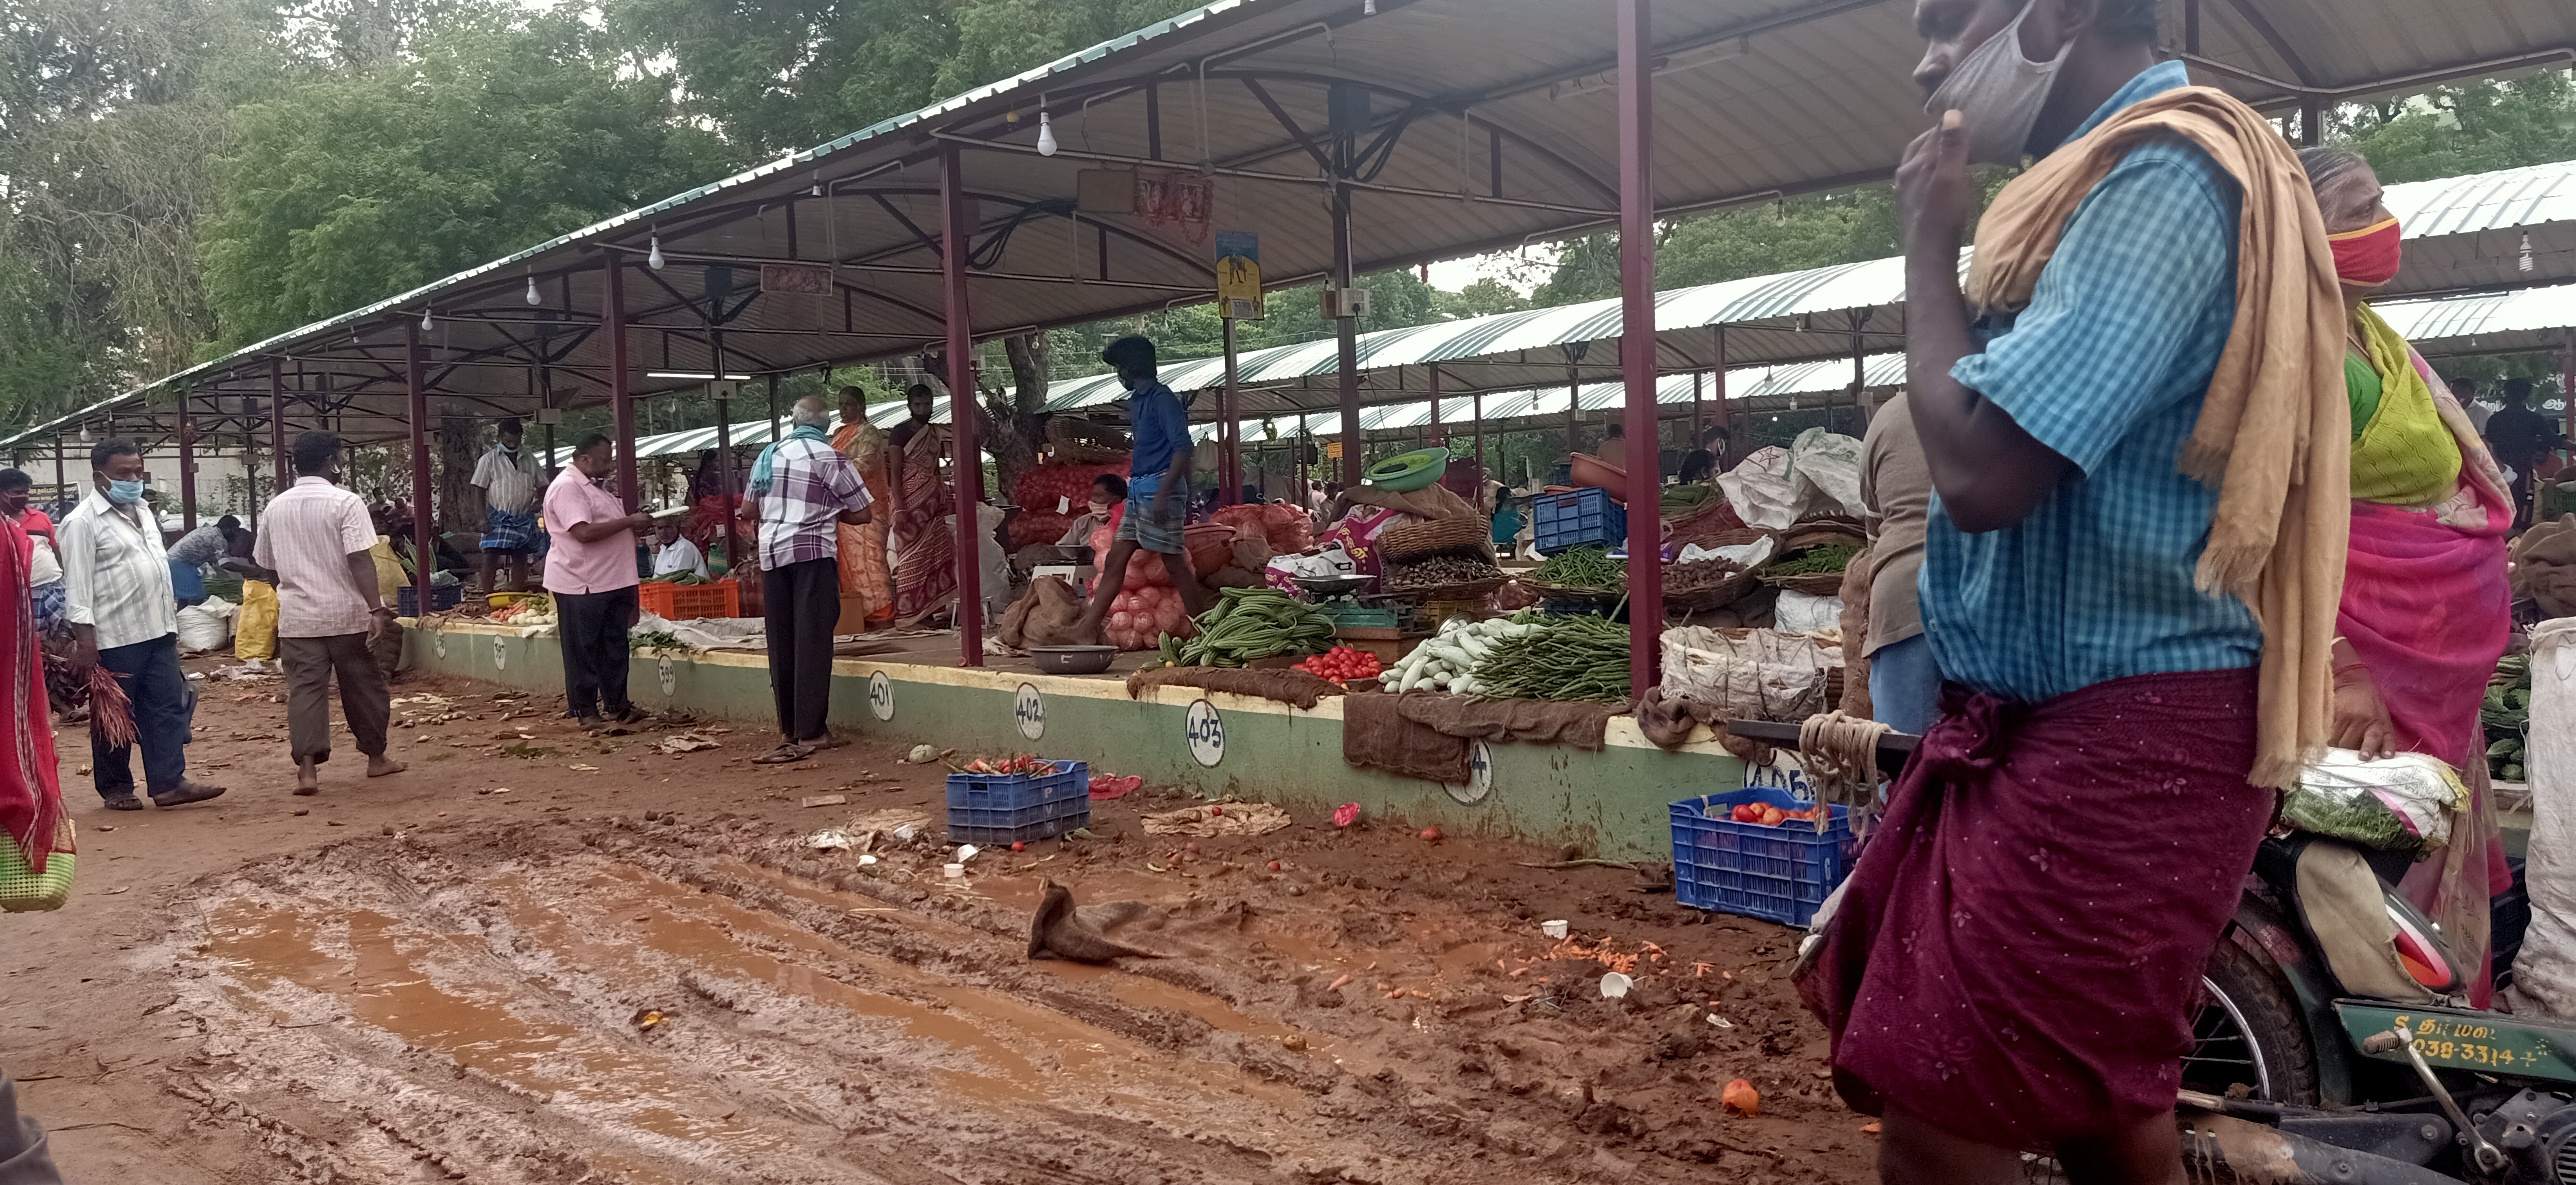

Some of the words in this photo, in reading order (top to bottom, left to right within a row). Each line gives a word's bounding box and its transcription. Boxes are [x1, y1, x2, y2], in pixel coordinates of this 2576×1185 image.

[495, 643, 505, 659] 397
[659, 665, 674, 685] 399
[869, 682, 889, 706] 401
[1017, 697, 1043, 726] 402
[1188, 716, 1222, 748] 403
[2414, 1038, 2515, 1066] 038-3314
